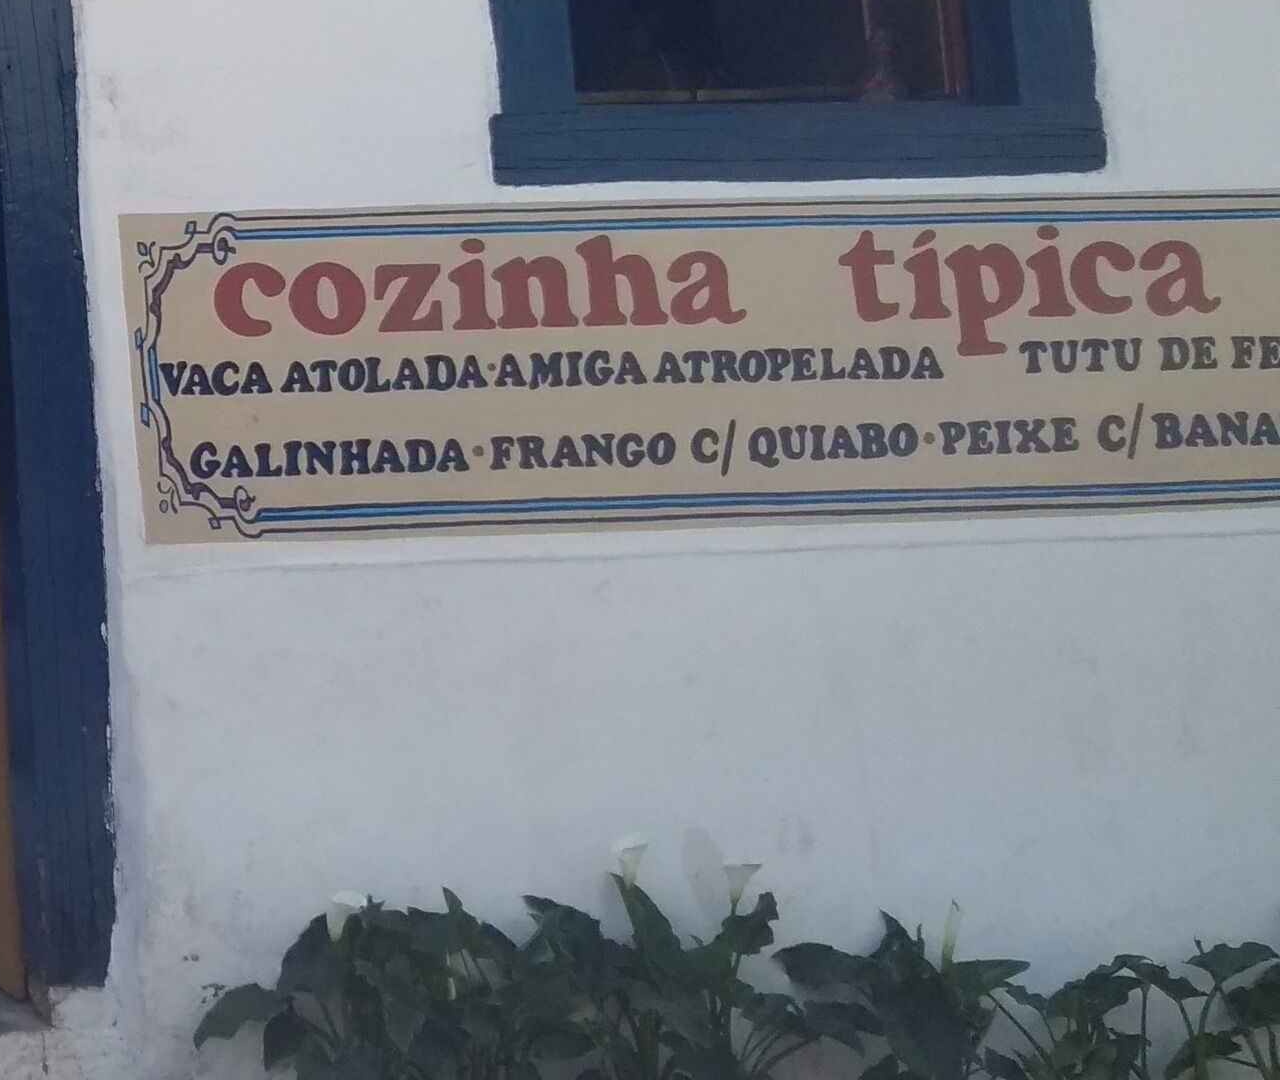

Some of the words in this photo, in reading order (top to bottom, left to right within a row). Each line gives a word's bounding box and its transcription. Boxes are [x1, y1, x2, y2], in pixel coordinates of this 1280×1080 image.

[213, 235, 748, 338] cozinha
[837, 225, 1222, 357] típica
[159, 360, 273, 397] VACA
[652, 346, 945, 385] ATROPELADA
[1018, 338, 1144, 374] TUTU
[1157, 336, 1218, 371] DE
[1230, 335, 1280, 370] FE
[1150, 411, 1280, 450] BANA
